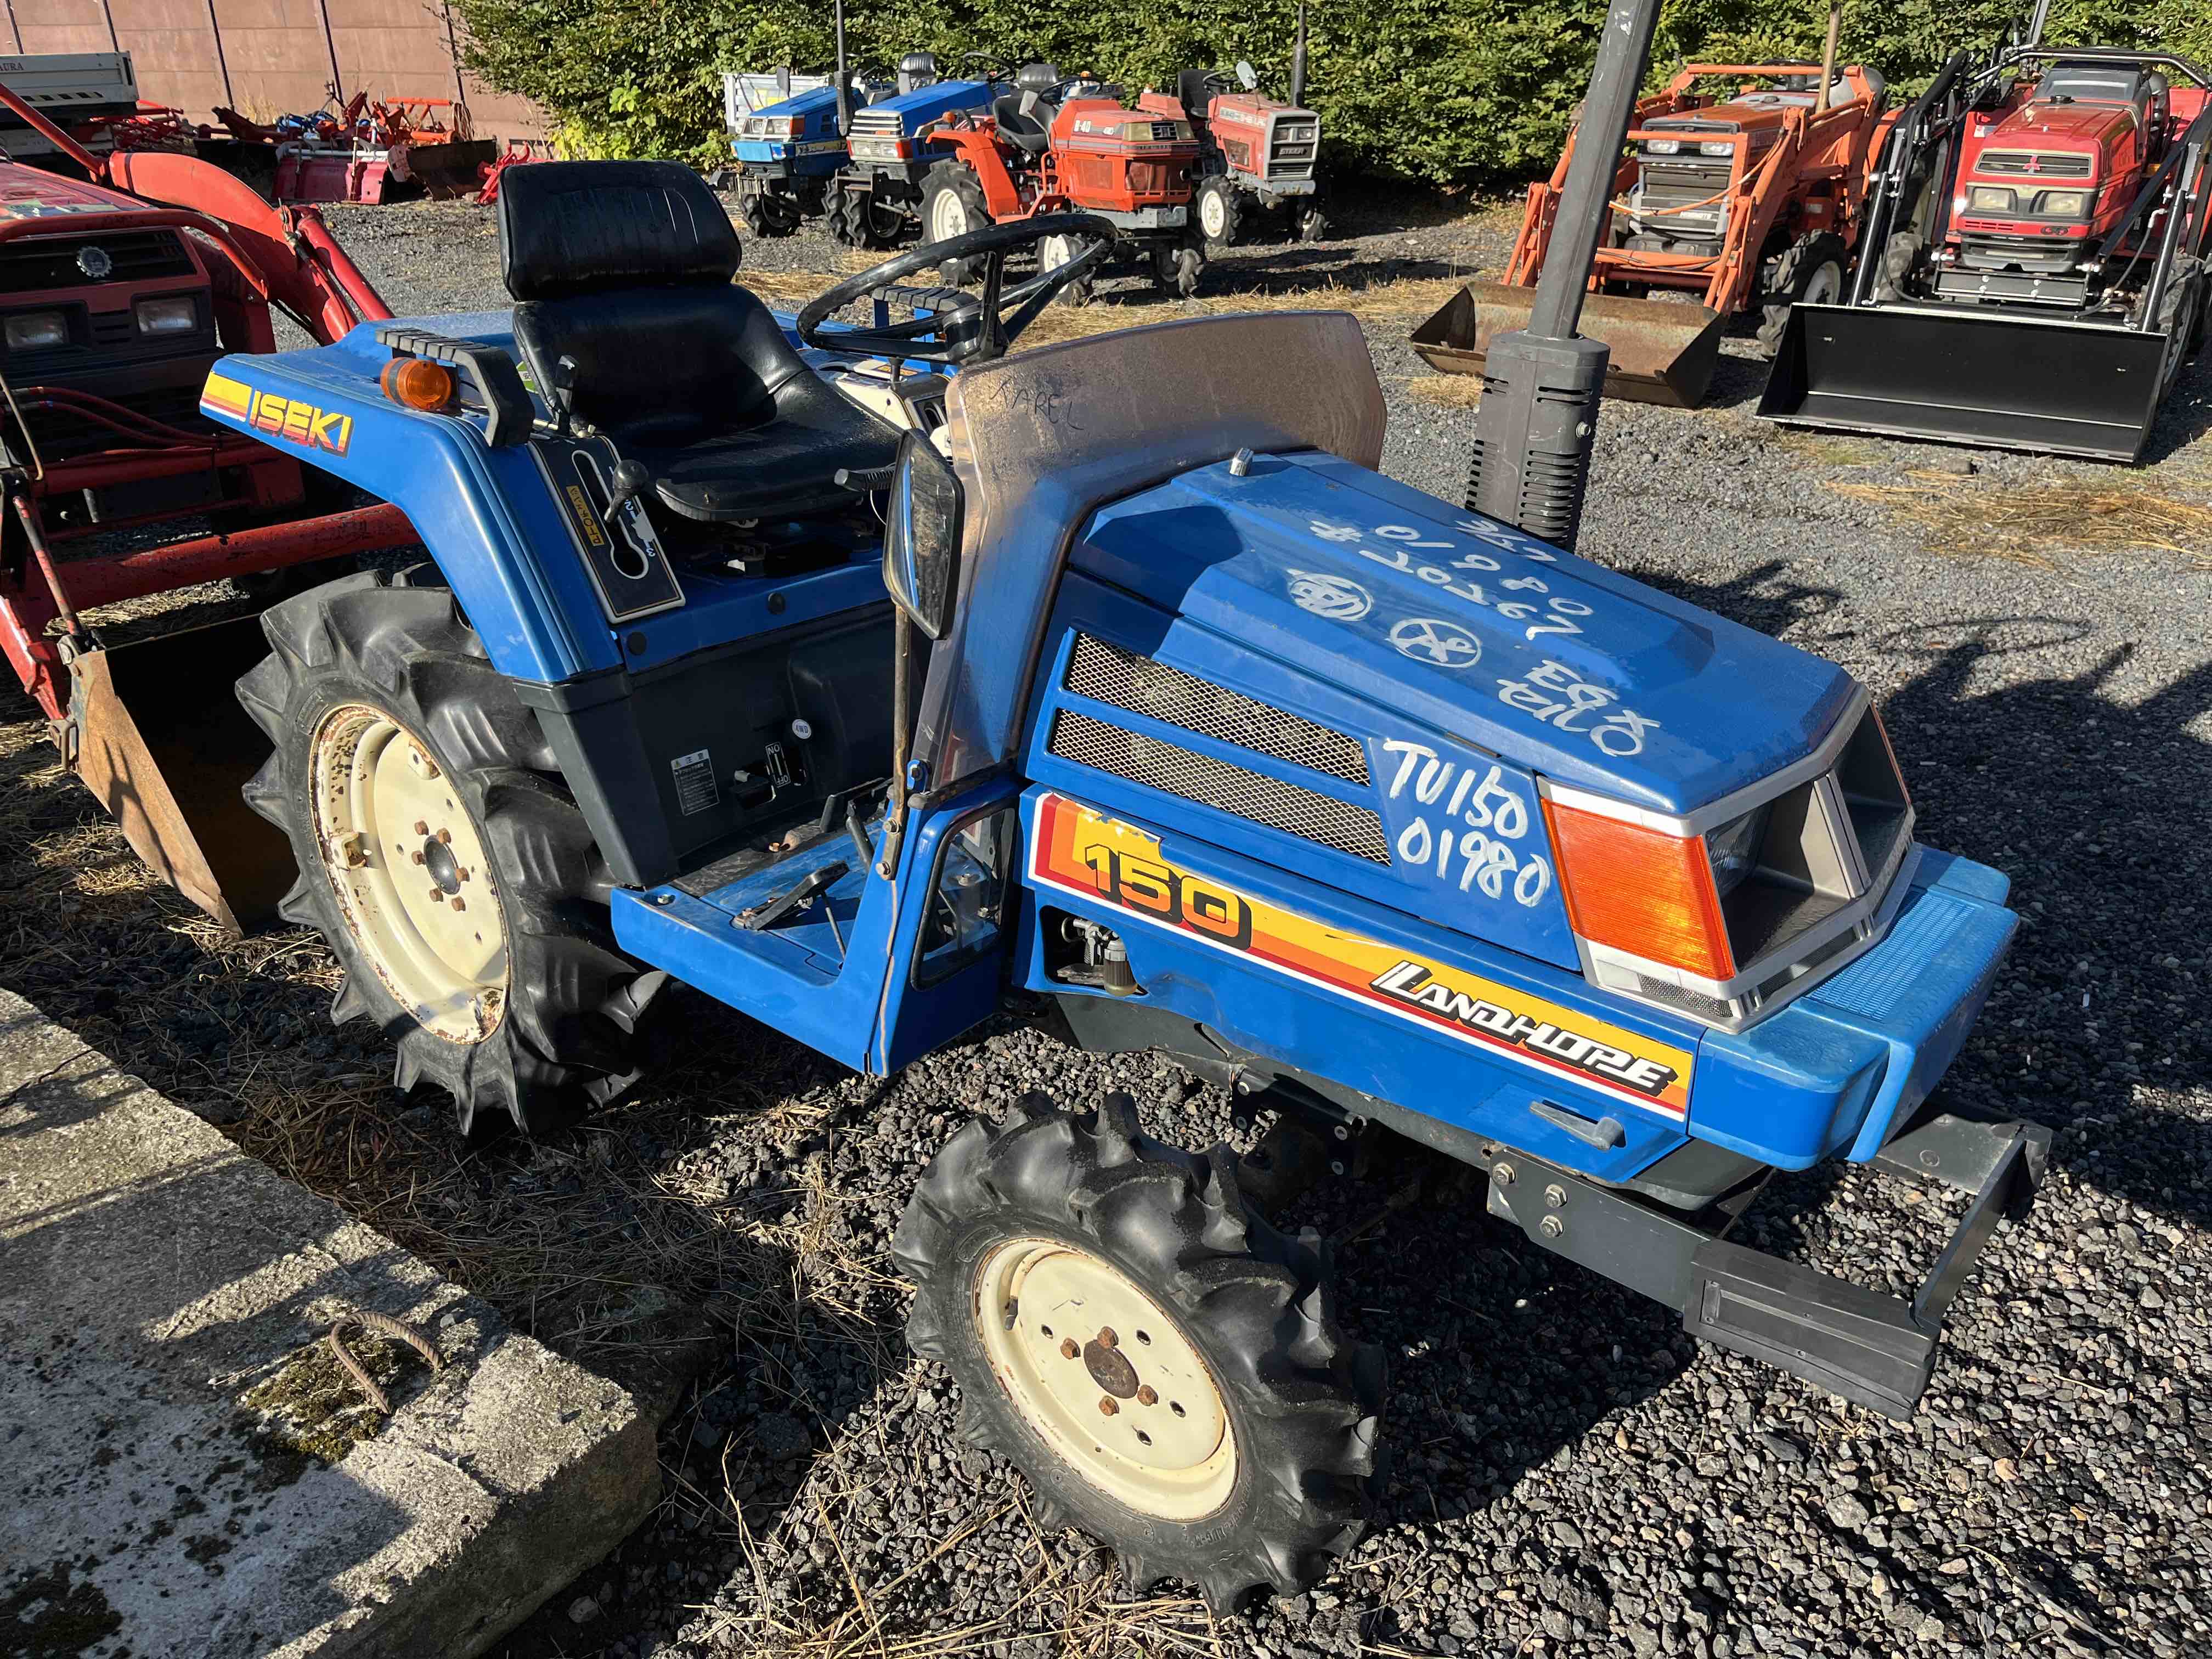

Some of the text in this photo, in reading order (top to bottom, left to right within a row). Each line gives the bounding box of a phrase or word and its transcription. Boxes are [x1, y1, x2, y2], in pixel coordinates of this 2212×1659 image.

[250, 390, 354, 458] ISEKI
[768, 744, 780, 755] ON
[776, 775, 789, 785] OFF
[1383, 738, 1528, 839] TU150
[1085, 844, 1251, 950] 150
[1397, 816, 1551, 907] 01980
[1369, 960, 1678, 1097] LANDHOPE
